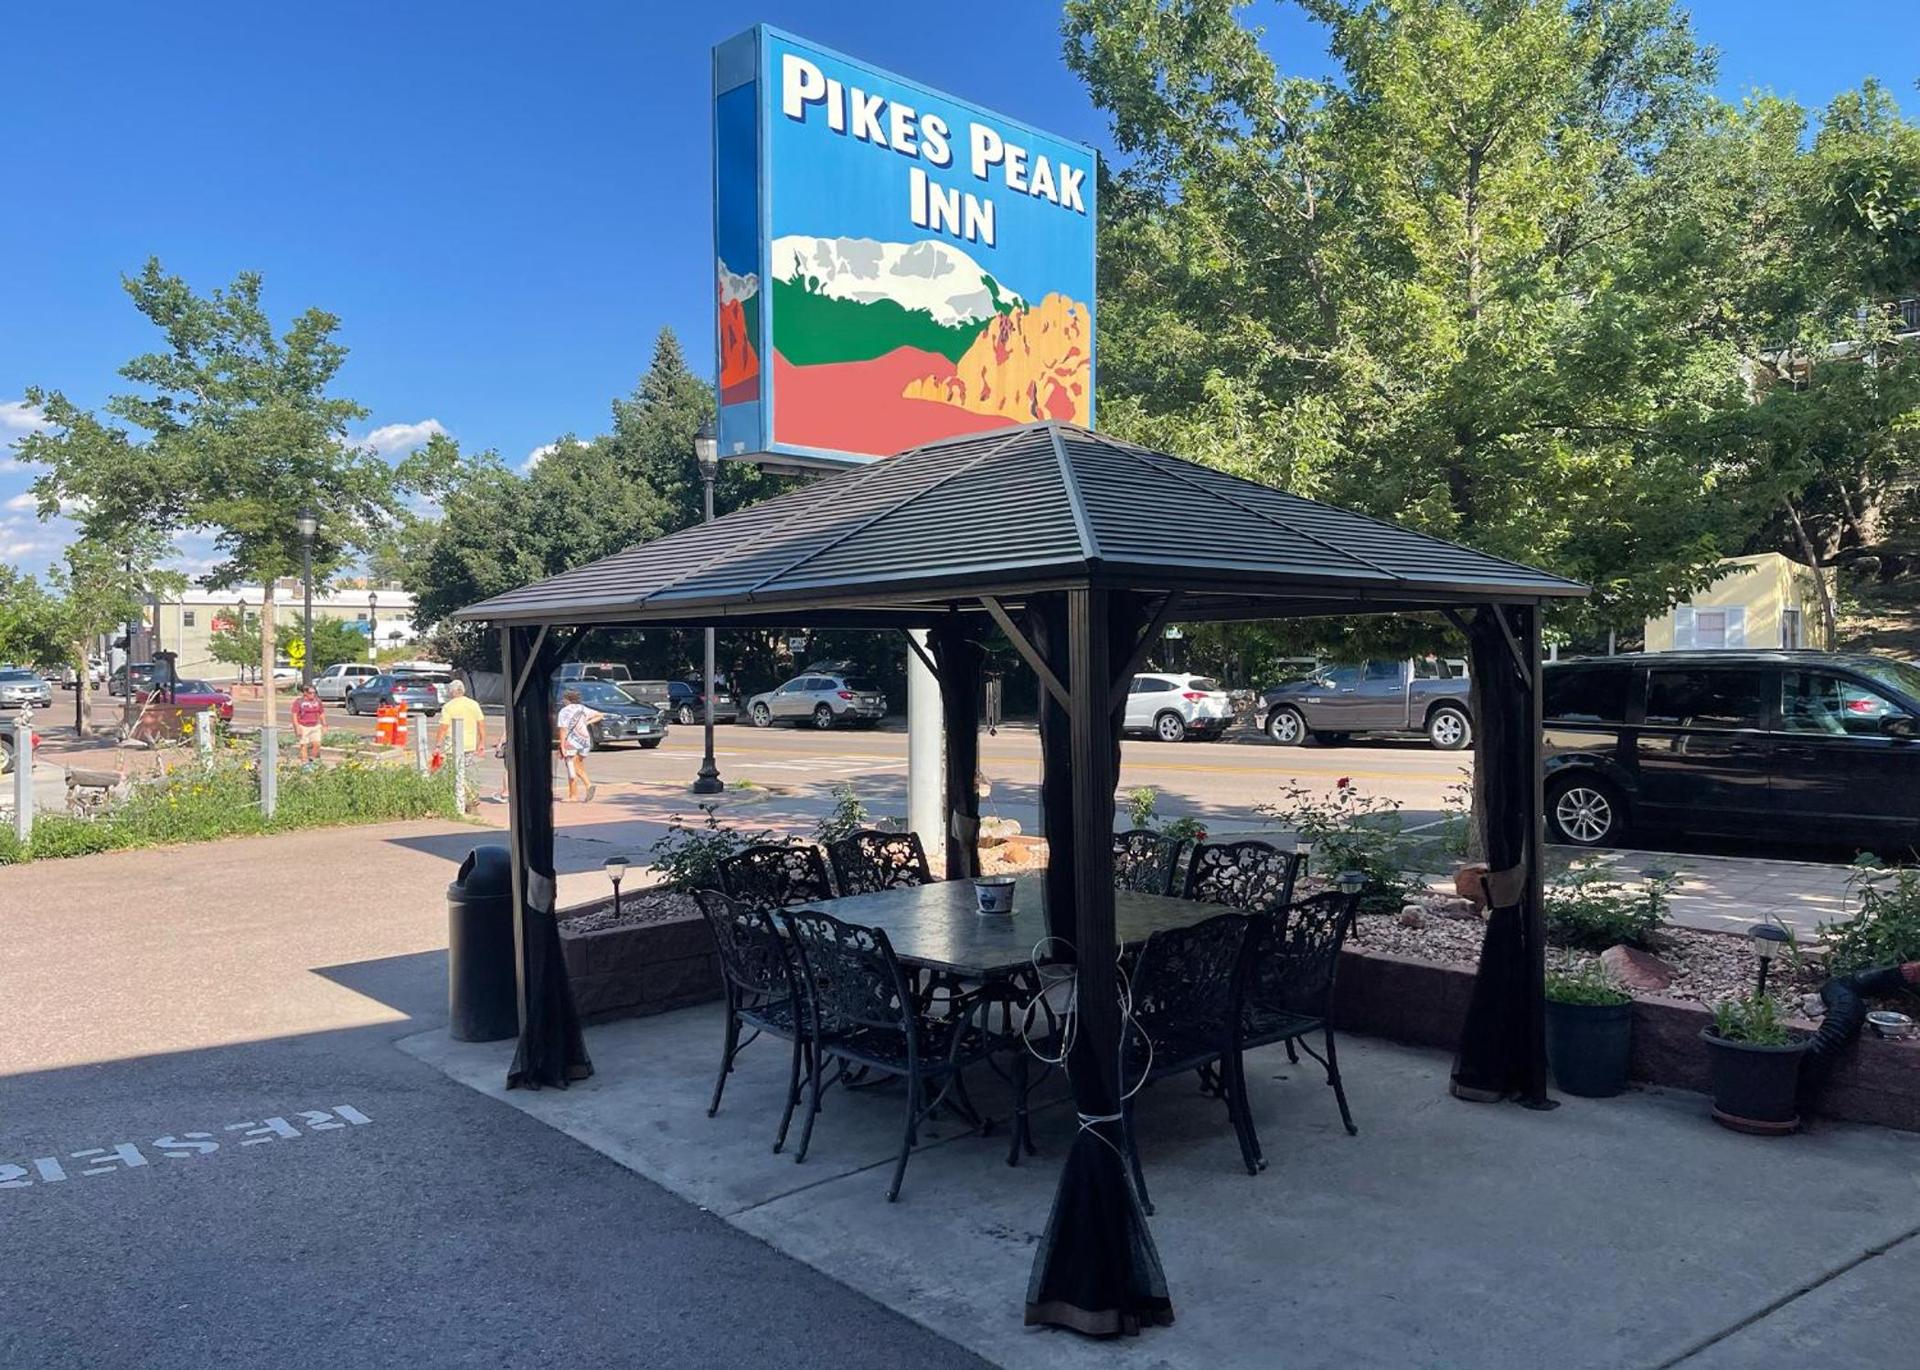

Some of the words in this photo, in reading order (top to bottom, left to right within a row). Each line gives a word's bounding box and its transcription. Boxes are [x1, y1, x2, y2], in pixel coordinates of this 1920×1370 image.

[782, 53, 952, 168] PIKES
[969, 122, 1086, 214] PEAK
[909, 167, 996, 249] INN
